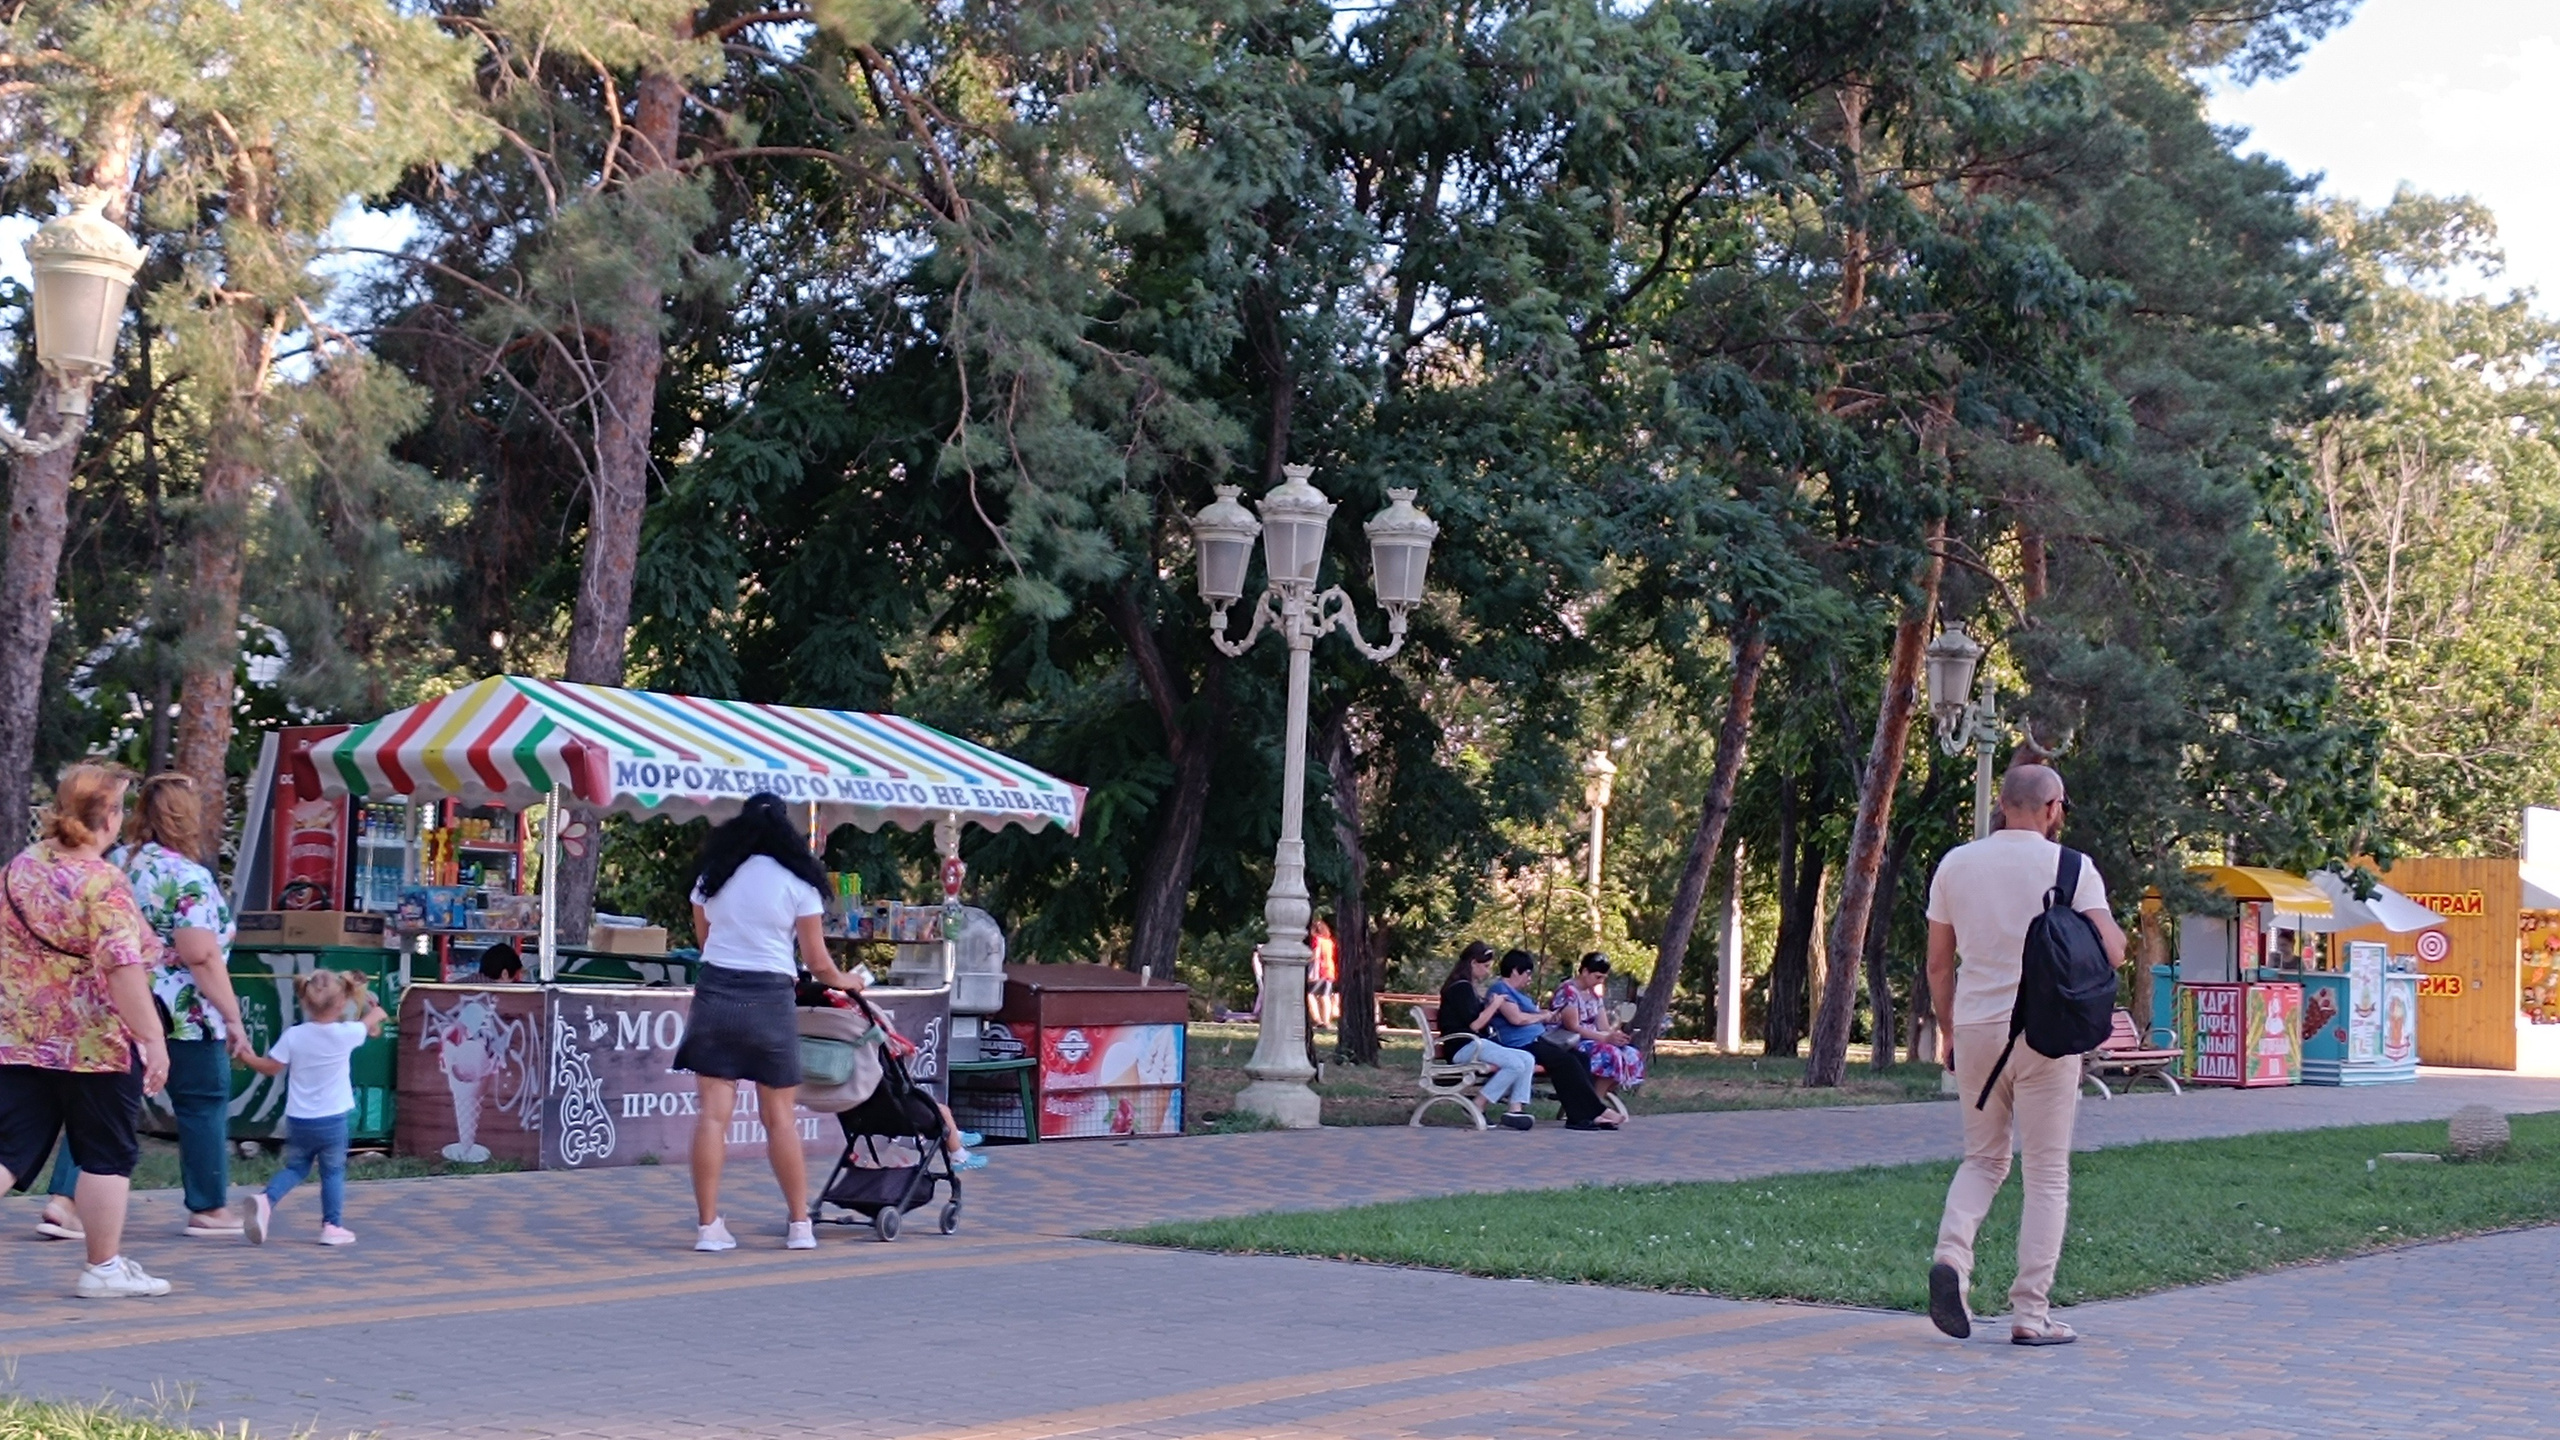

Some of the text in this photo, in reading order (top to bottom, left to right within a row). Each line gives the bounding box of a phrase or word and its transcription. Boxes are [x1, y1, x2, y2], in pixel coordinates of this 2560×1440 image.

[616, 760, 1073, 816] МОРОЖЕНОГО МНОГО НЕ БЫВАЕТ
[2417, 975, 2462, 995] РИЗ
[2197, 990, 2238, 1014] КАРТ
[2197, 1014, 2237, 1034] ОФЕЛ
[2197, 1034, 2237, 1054] ЬНЫЙ
[2197, 1055, 2238, 1078] ПАПА
